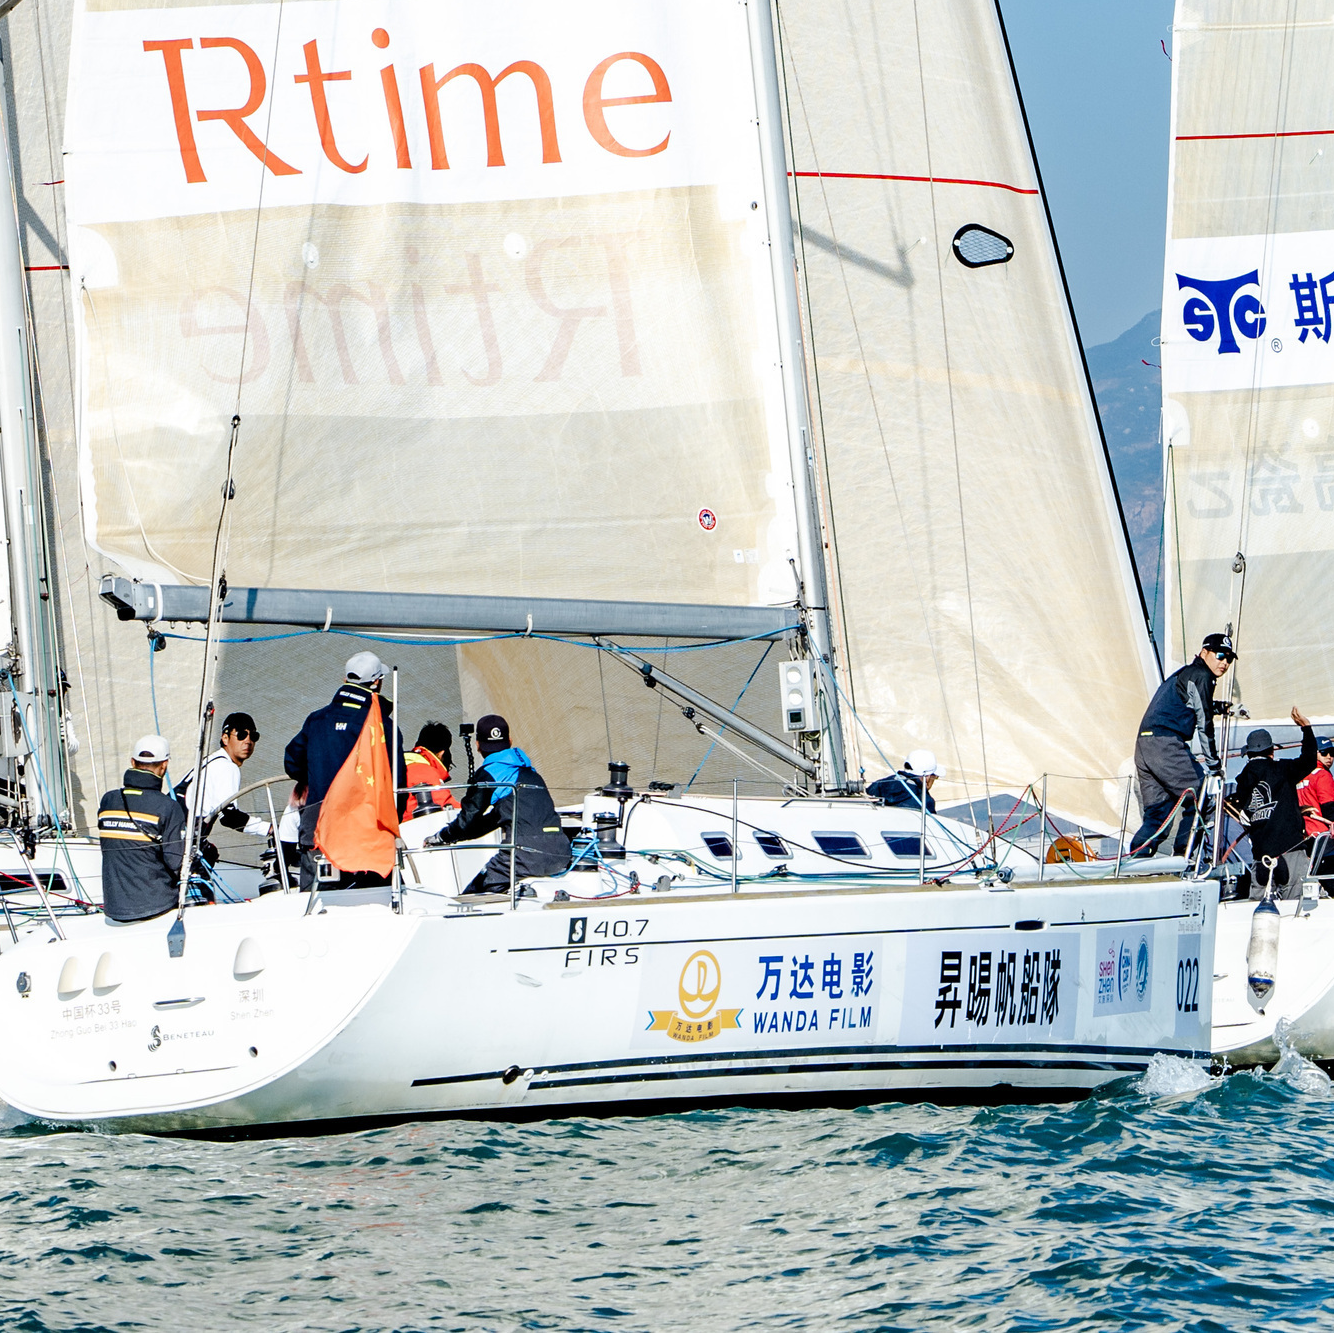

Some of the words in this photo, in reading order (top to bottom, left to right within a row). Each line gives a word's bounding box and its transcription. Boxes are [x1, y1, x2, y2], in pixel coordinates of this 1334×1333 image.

[142, 27, 673, 185] Rtime
[594, 919, 649, 938] 40.7
[756, 950, 874, 1001] 万达电影
[1176, 957, 1199, 1013] 022
[238, 988, 265, 1003] 深圳
[62, 999, 122, 1022] 中国杯33号
[230, 1010, 251, 1021] Shen
[253, 1008, 275, 1019] Zhen
[753, 1009, 819, 1034] WANDA
[828, 1005, 872, 1031] FILM
[50, 1028, 74, 1040] Zhong
[76, 1025, 91, 1036] Guo
[94, 1023, 106, 1033] Bei
[109, 1021, 119, 1031] 33
[121, 1018, 137, 1028] Hao
[163, 1030, 215, 1042] BENETEAU
[673, 1032, 695, 1042] WANDA
[698, 1031, 715, 1041] FILM
[674, 1021, 714, 1034] 万达电影
